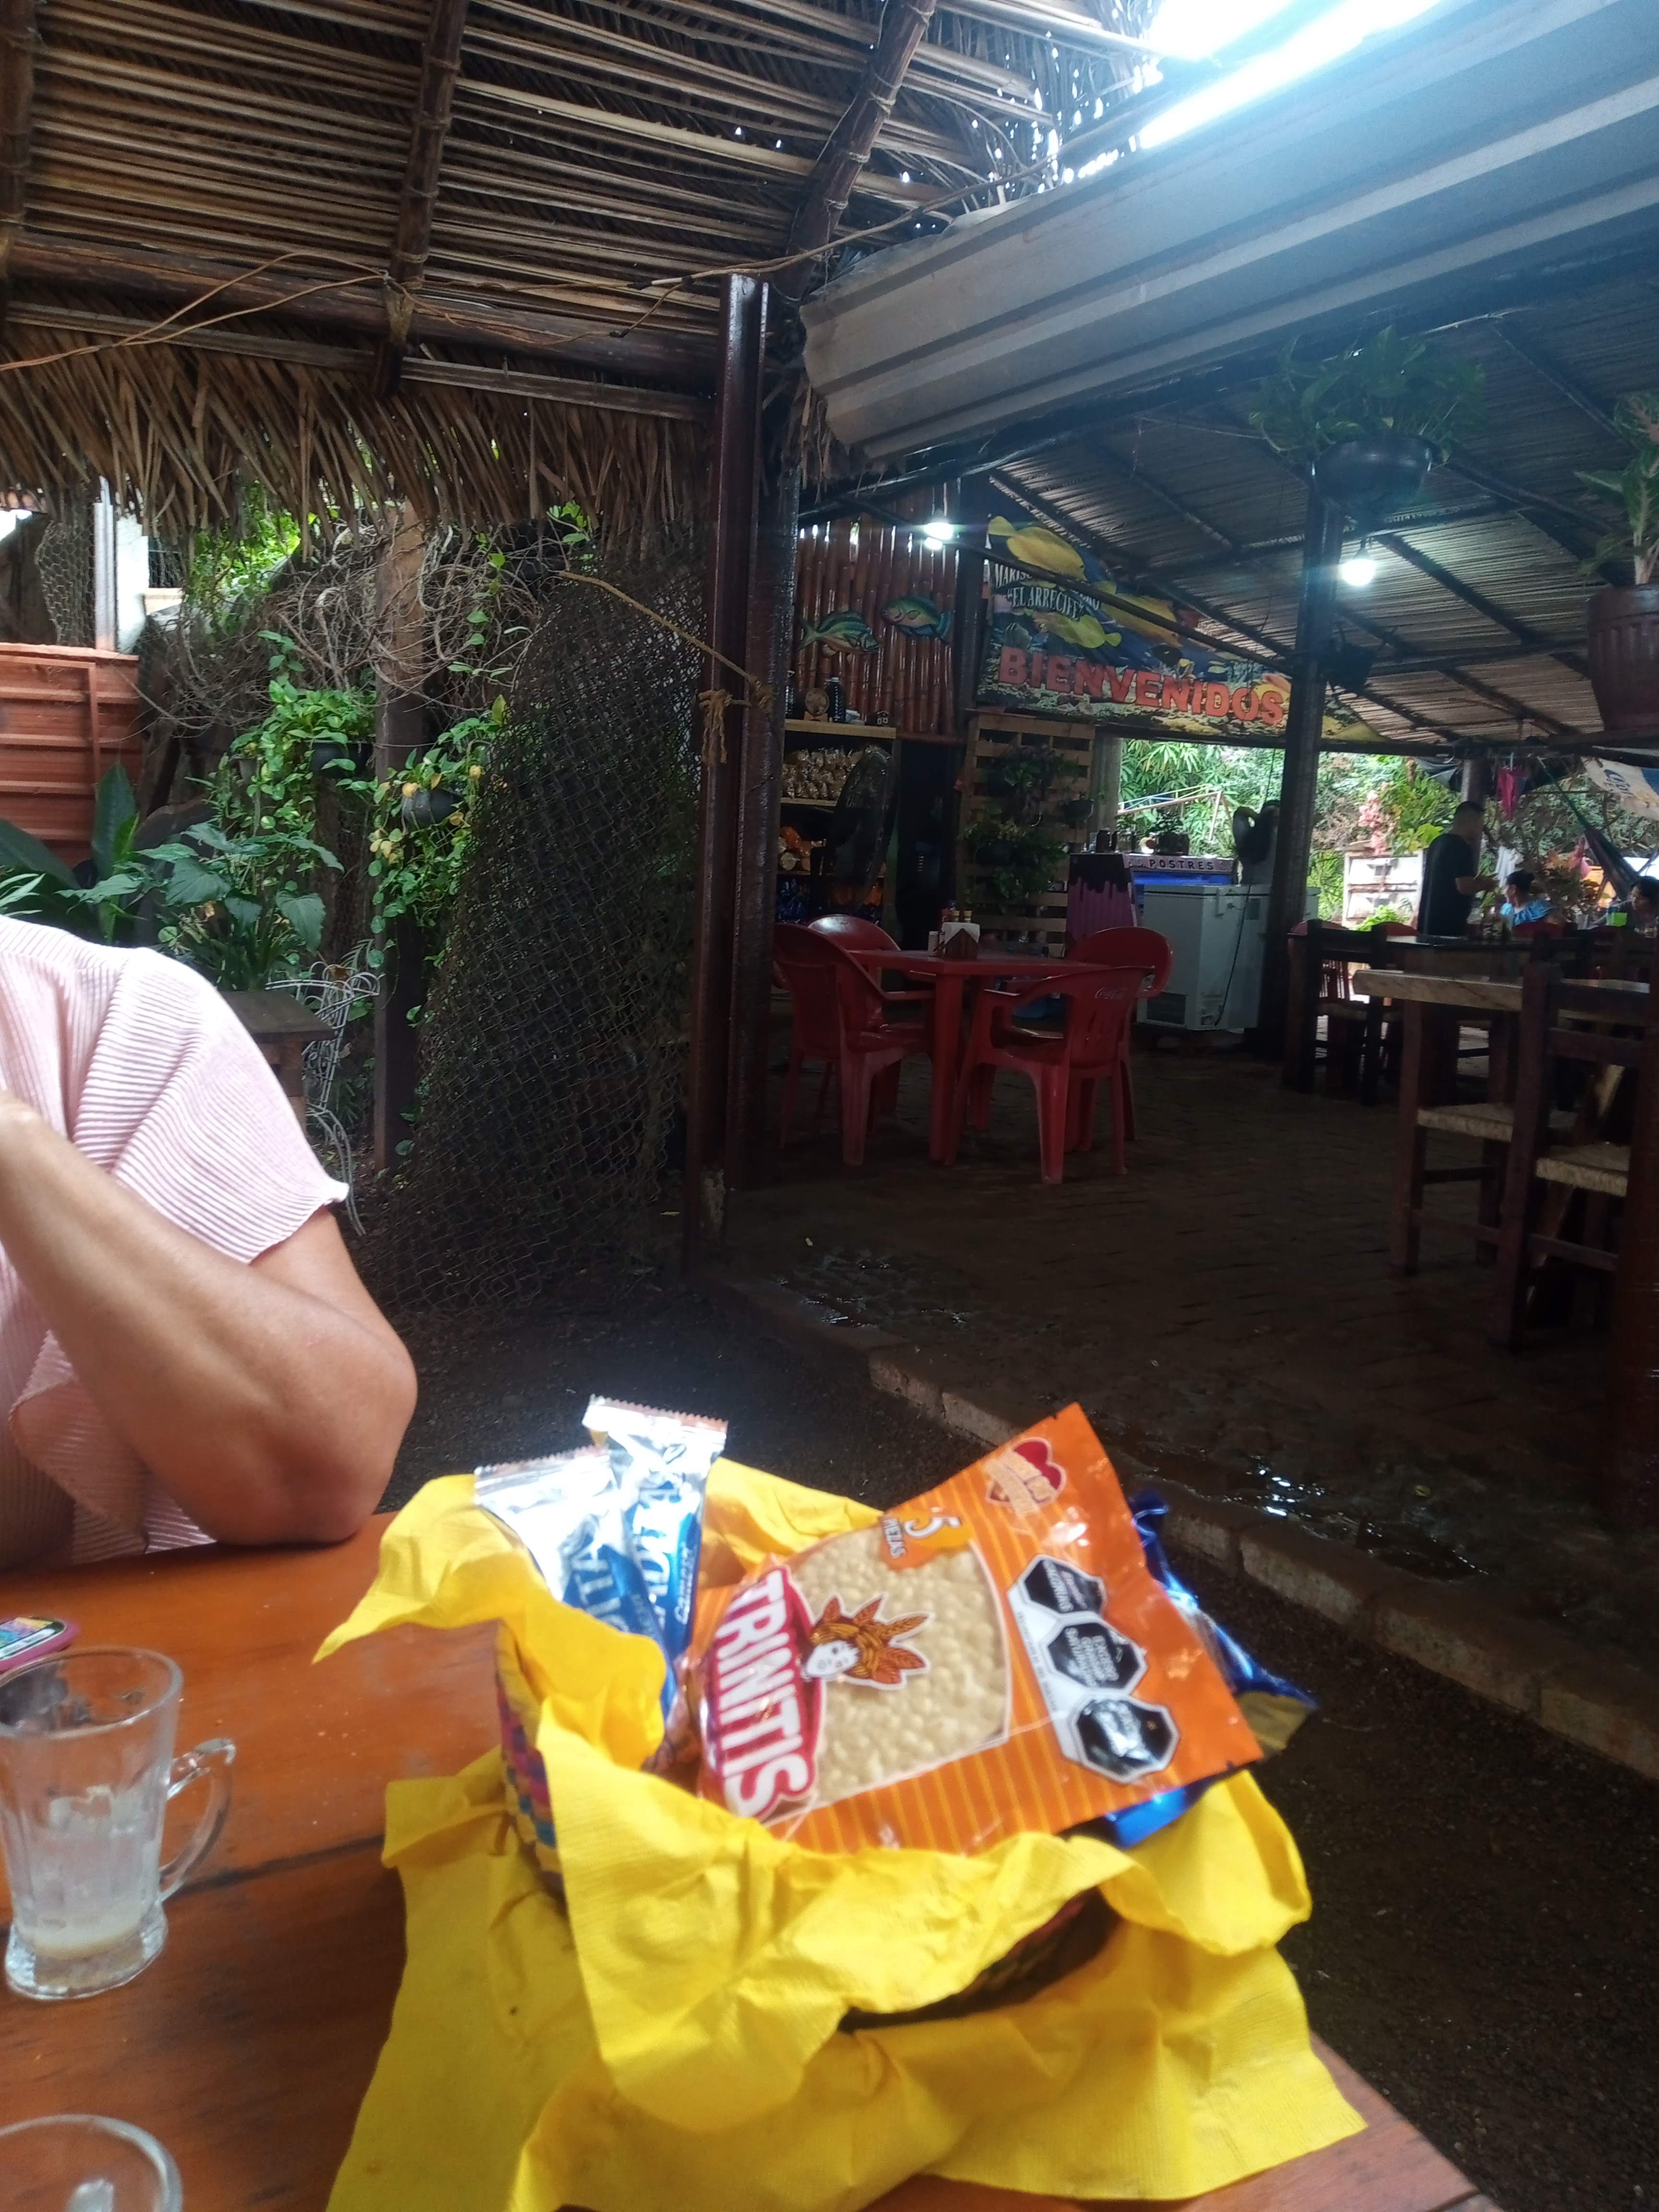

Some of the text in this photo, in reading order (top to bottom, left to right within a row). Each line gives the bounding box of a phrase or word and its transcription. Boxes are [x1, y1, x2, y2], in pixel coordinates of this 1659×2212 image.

[998, 646, 1285, 726] BIENVENIDOS
[1149, 859, 1214, 870] POSTRES
[906, 1516, 961, 1538] 5
[716, 1572, 811, 1818] TRINITIS
